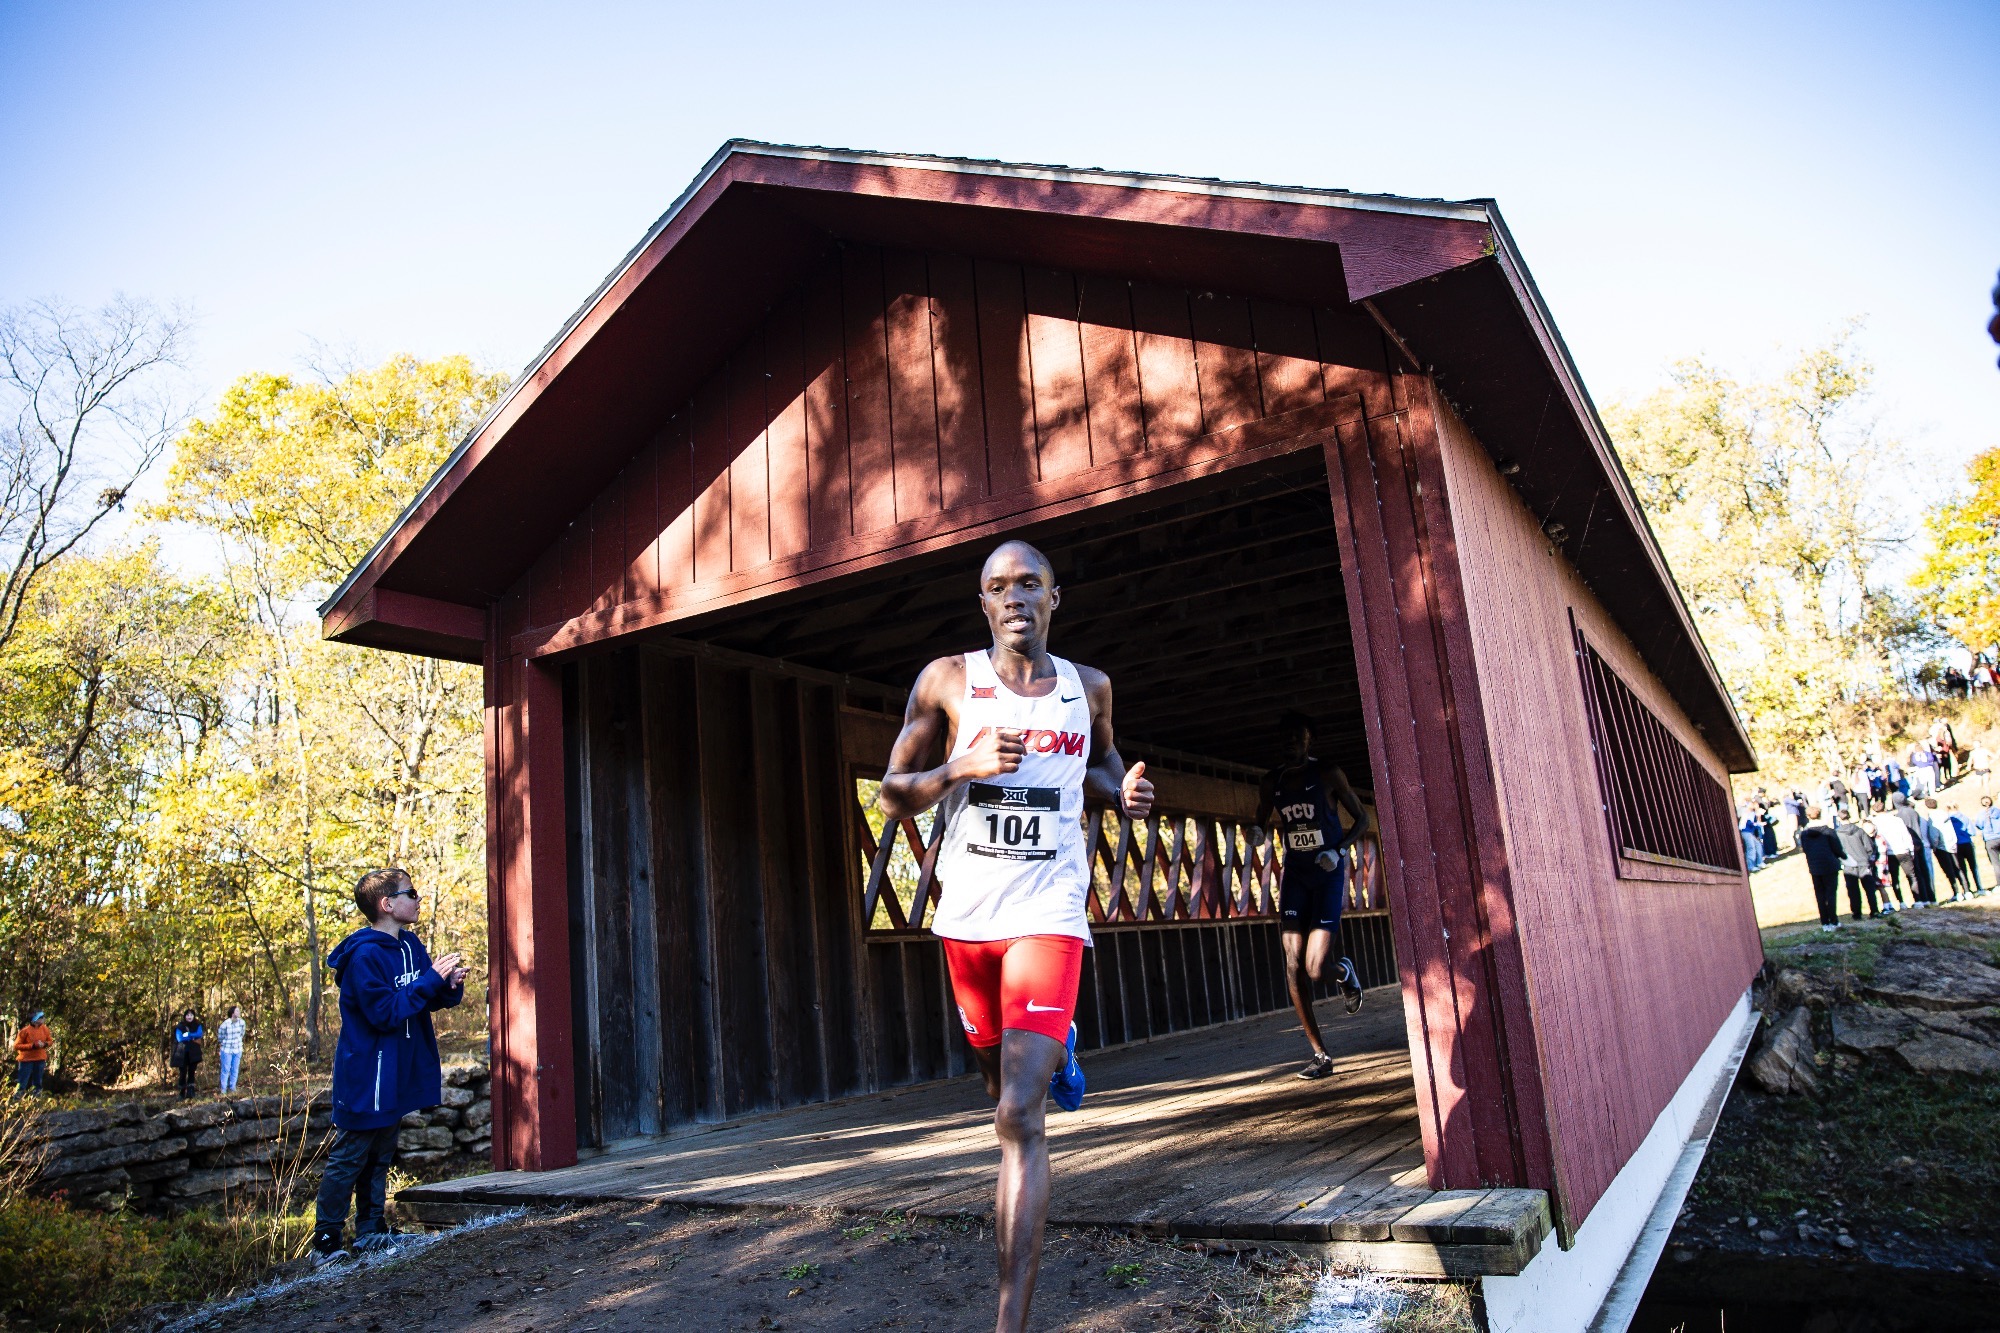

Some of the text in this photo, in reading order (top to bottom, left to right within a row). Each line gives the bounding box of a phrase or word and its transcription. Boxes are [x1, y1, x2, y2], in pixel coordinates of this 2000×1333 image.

[967, 726, 1085, 757] AZONA
[1281, 803, 1314, 822] TCU
[985, 813, 1041, 846] 104
[1294, 833, 1316, 846] 204
